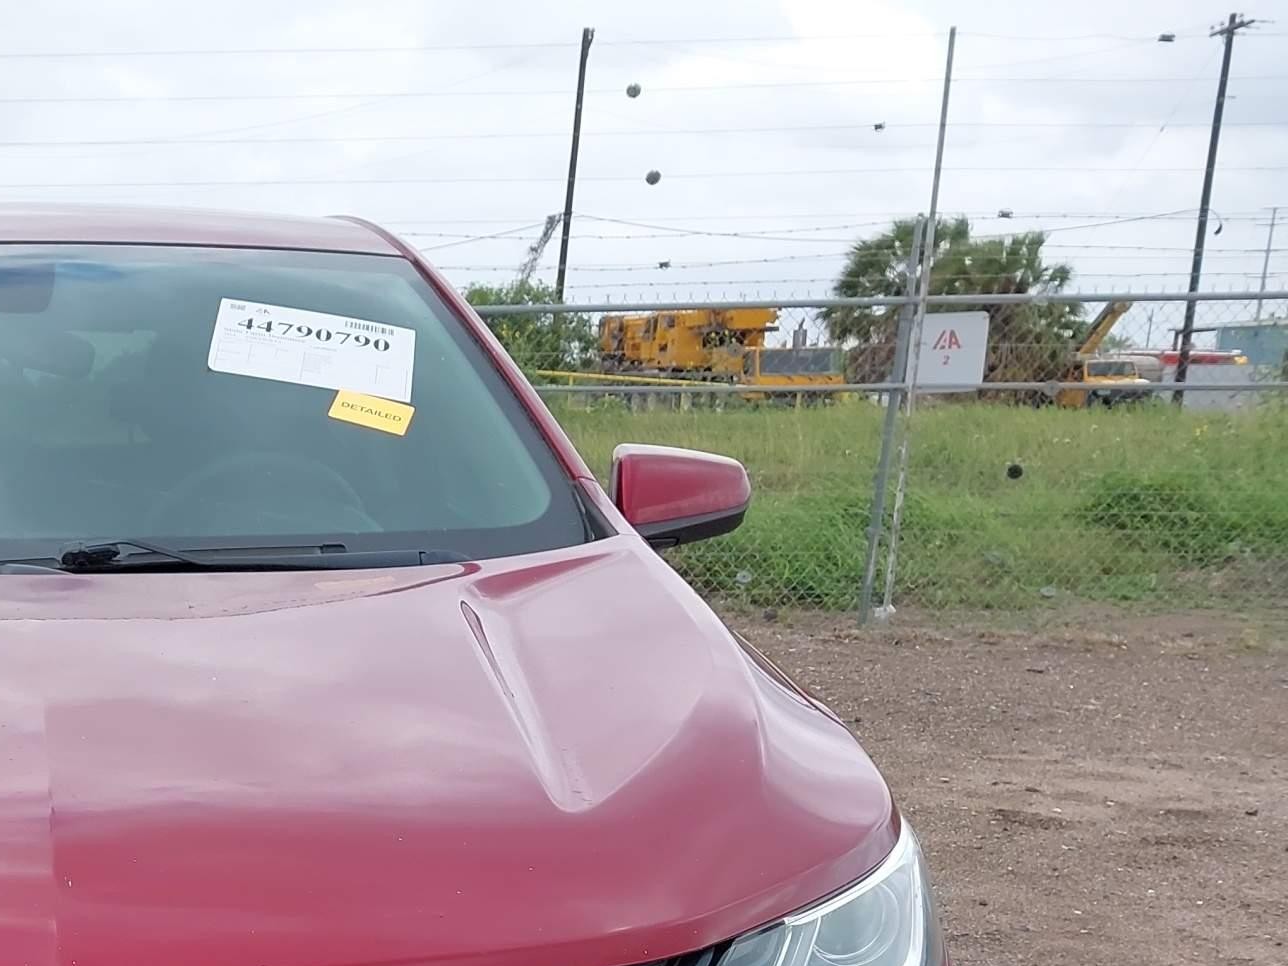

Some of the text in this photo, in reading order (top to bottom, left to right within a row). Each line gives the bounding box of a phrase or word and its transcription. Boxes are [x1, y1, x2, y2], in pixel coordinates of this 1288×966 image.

[237, 317, 390, 352] 44790790
[942, 354, 951, 366] 2
[341, 401, 402, 422] DETAILED
